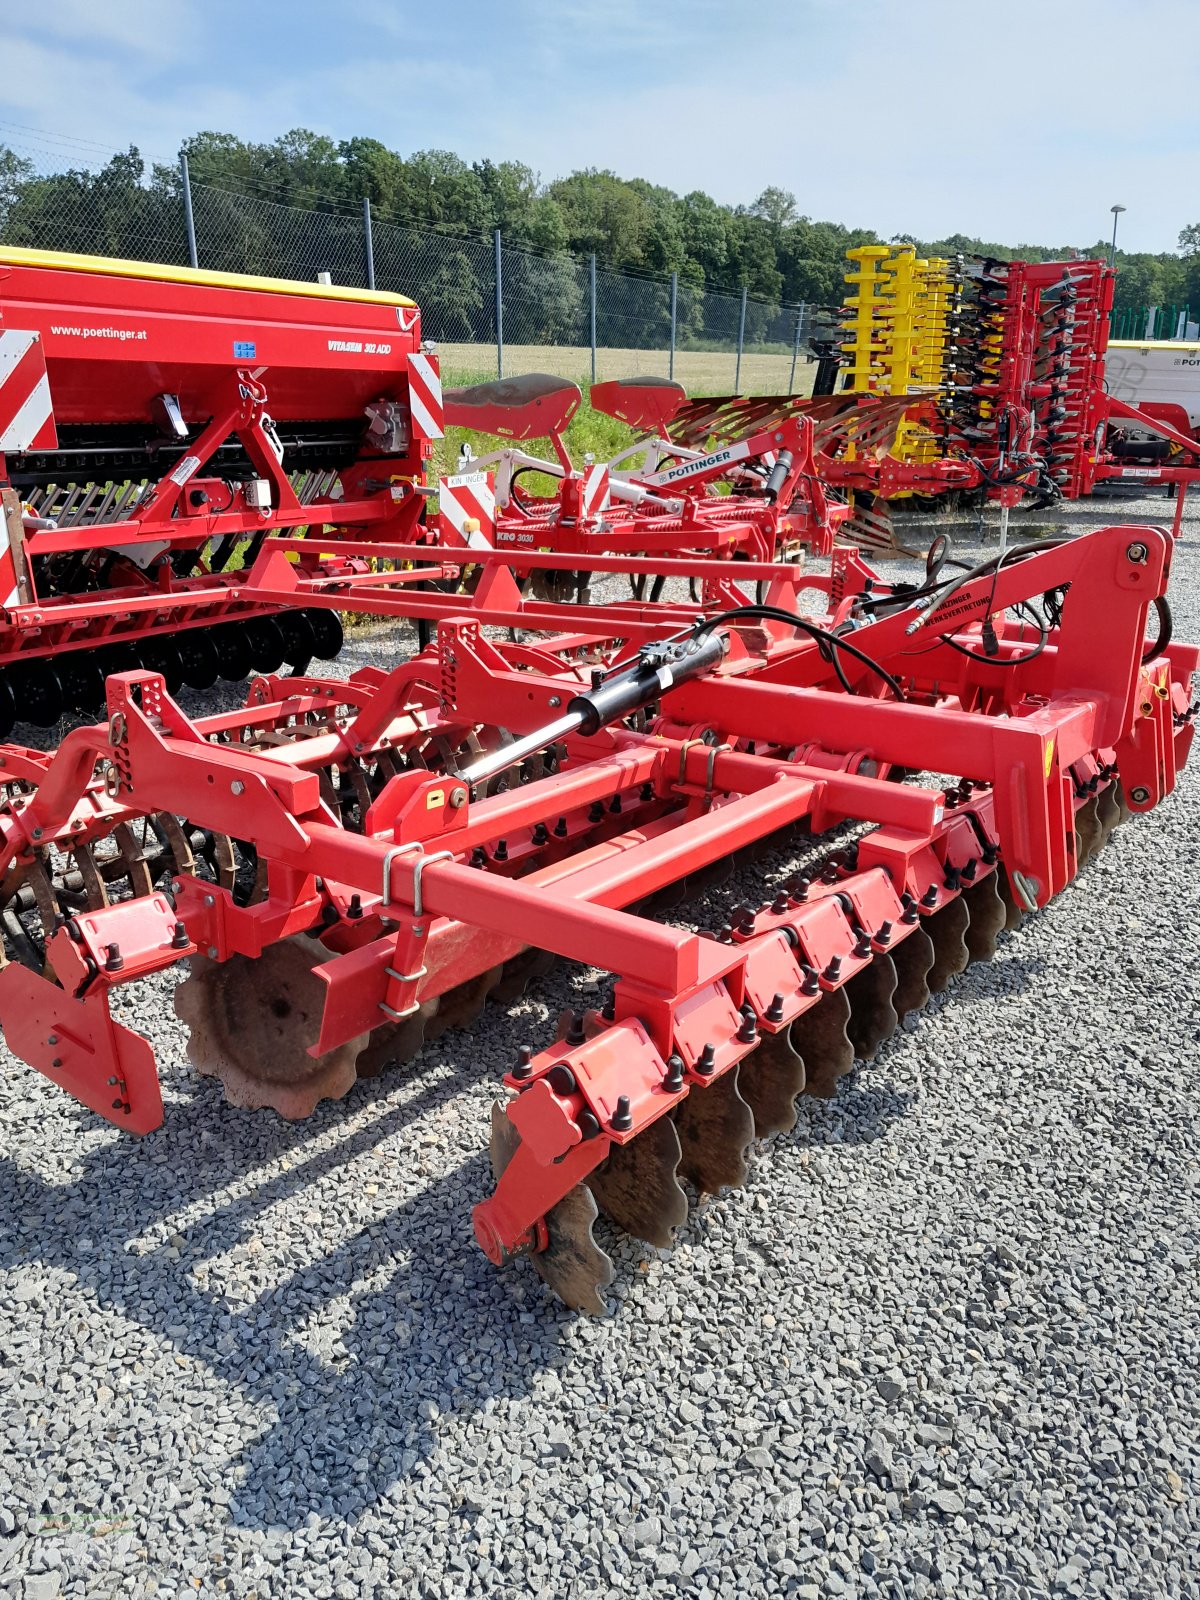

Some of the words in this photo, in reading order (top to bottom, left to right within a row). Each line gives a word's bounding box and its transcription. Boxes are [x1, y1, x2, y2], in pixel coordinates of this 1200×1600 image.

[50, 326, 147, 340] www.poettinger.at
[327, 340, 363, 353] VITASEM
[364, 342, 377, 354] 302
[376, 343, 391, 355] ADD
[517, 533, 534, 543] 3030
